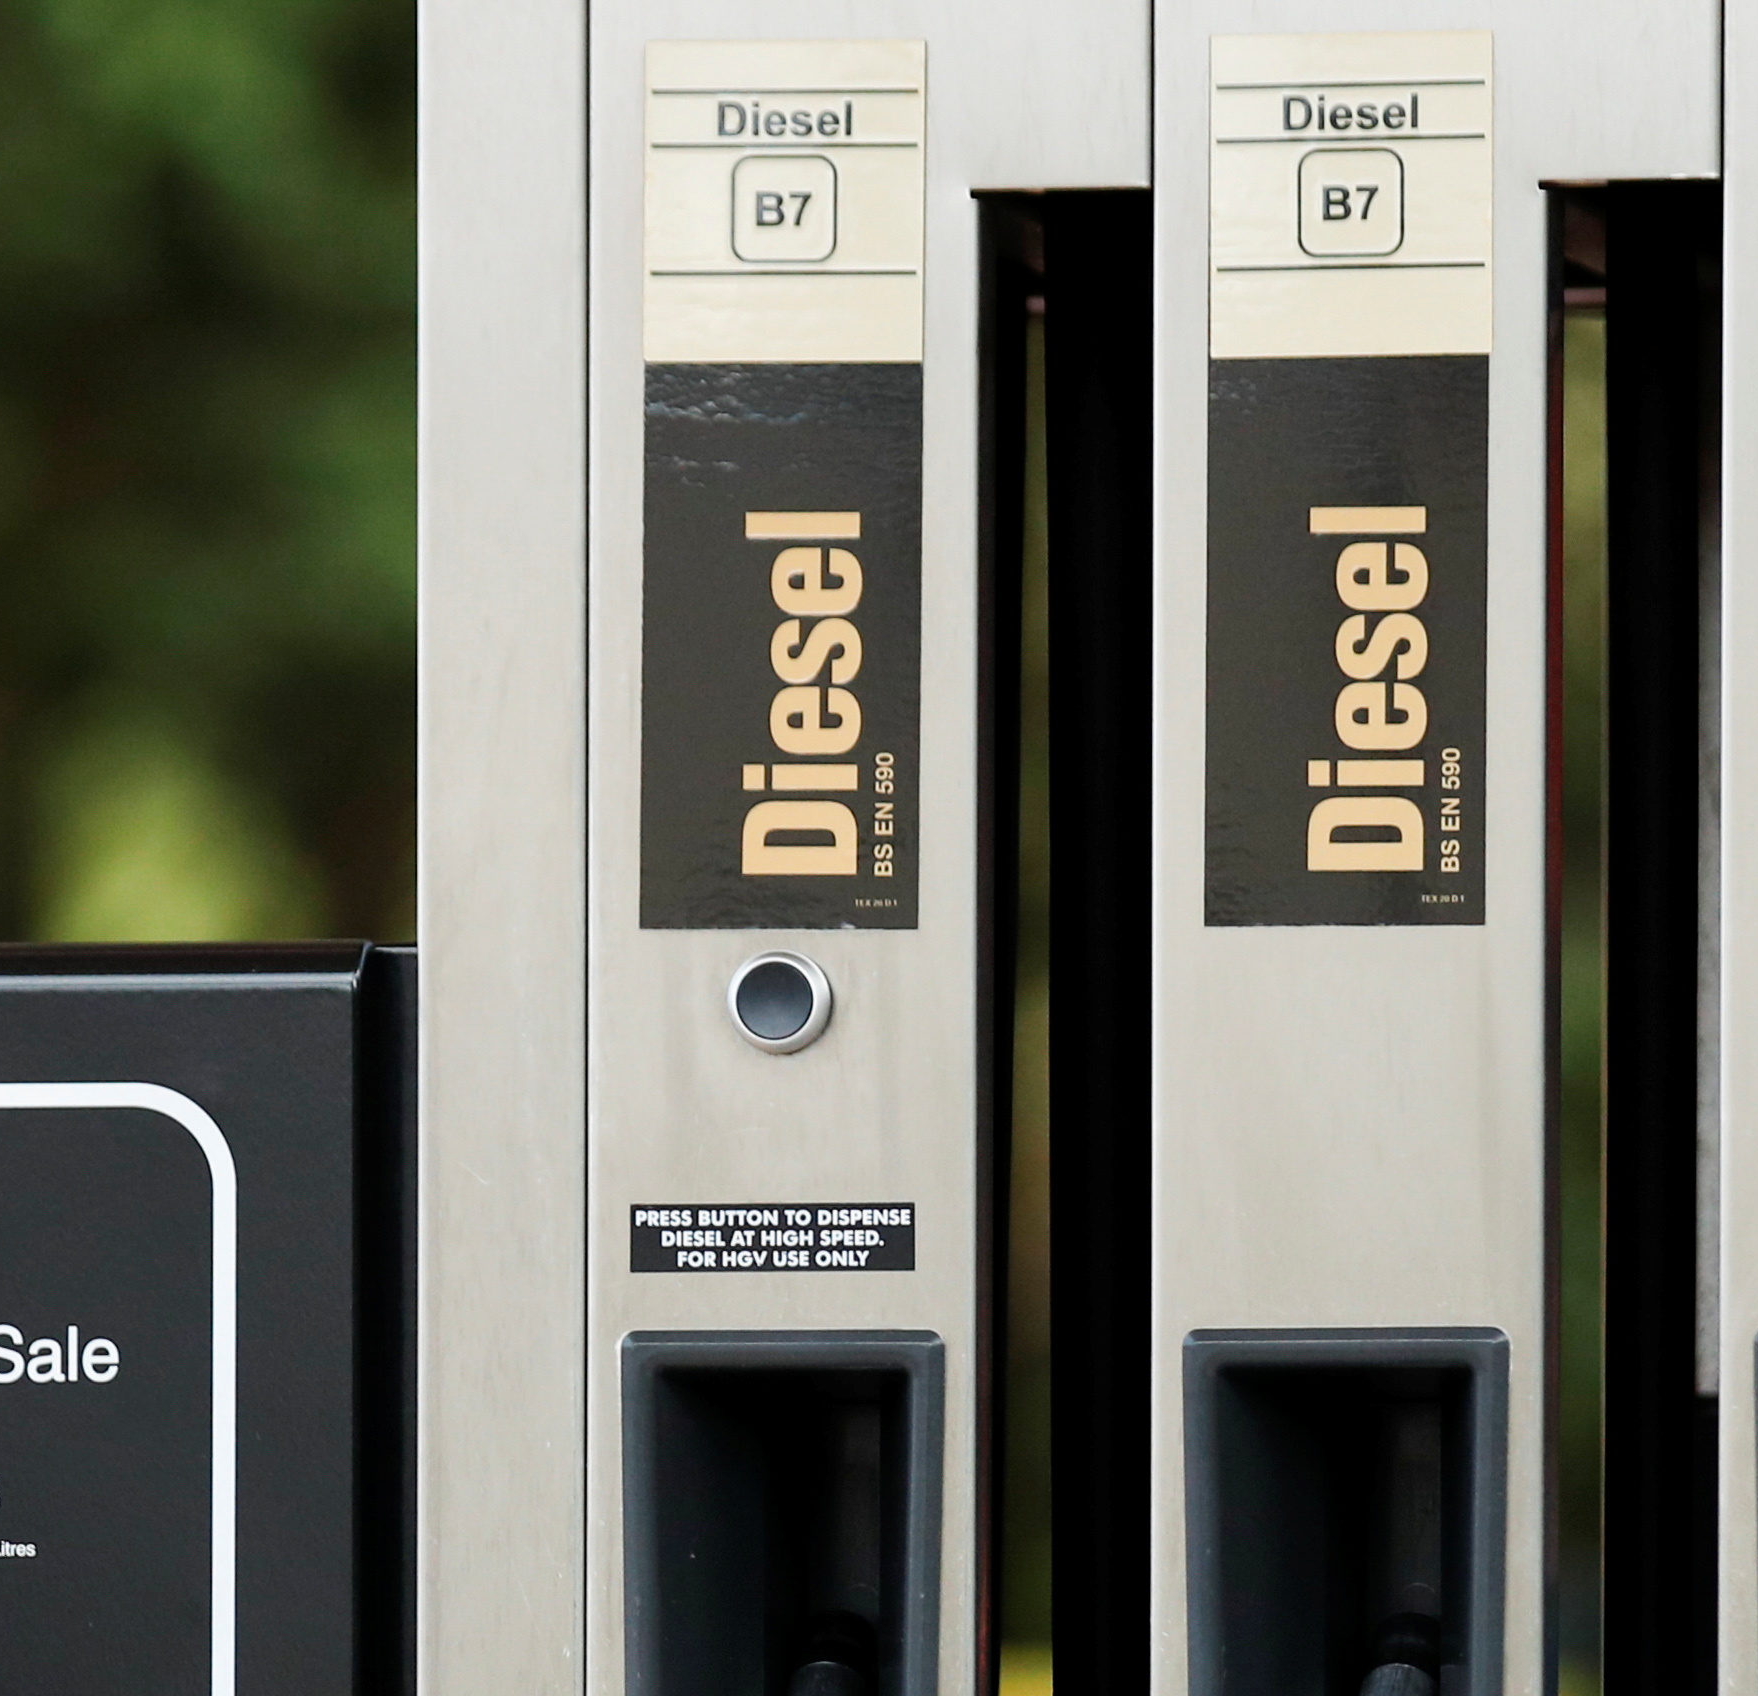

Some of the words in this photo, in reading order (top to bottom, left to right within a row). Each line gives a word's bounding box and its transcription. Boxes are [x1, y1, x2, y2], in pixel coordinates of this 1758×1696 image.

[718, 102, 852, 136] Diesel
[1284, 94, 1418, 130] Diesel
[756, 193, 811, 226] B7
[1323, 187, 1378, 221] B7
[742, 512, 862, 875] Diesel
[1308, 507, 1428, 871] Diesel
[875, 753, 894, 794] 590
[1442, 748, 1460, 789] 590
[875, 803, 893, 835] EN
[1441, 798, 1460, 831] EN
[874, 844, 893, 876] BS
[1441, 840, 1459, 872] BS
[636, 1210, 692, 1226] PRESS
[699, 1210, 778, 1226] BUTTON
[784, 1210, 811, 1226] TO
[818, 1209, 911, 1225] DISPENSE
[662, 1230, 725, 1247] DIESEL
[731, 1231, 755, 1246] AT
[761, 1230, 813, 1246] HIGH
[820, 1230, 884, 1246] SPEED.
[678, 1251, 716, 1267] FOR
[723, 1251, 767, 1267] HGV
[773, 1251, 809, 1267] USE
[815, 1250, 869, 1266] ONLY
